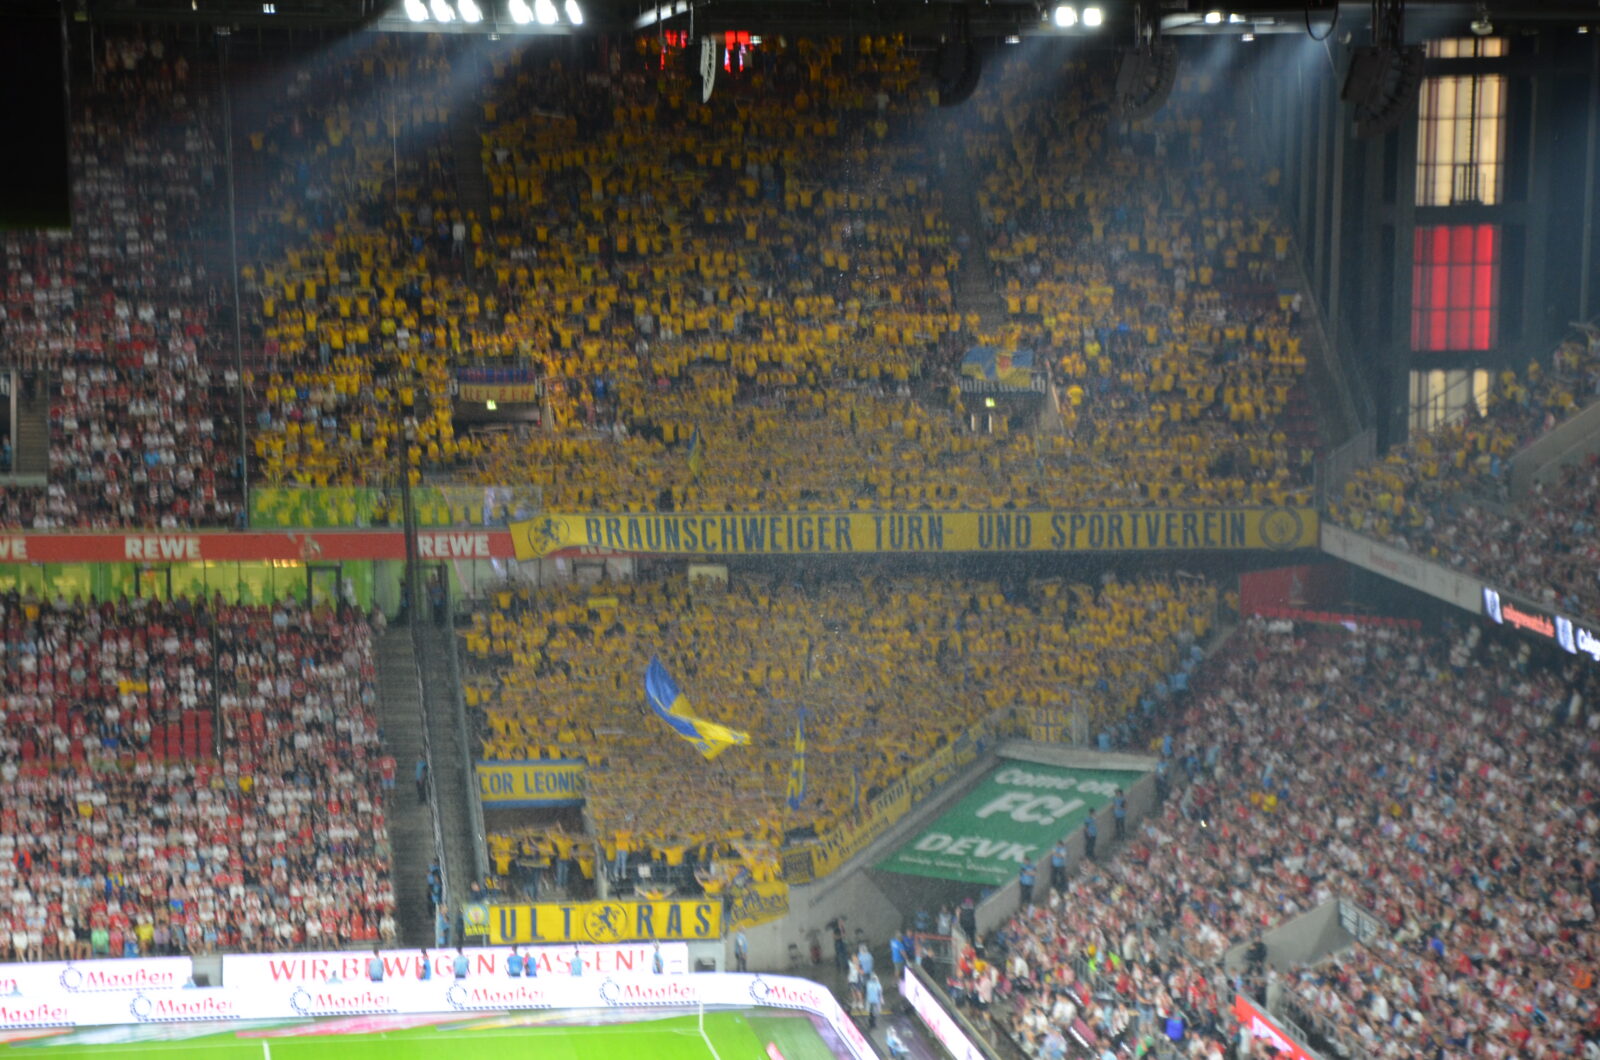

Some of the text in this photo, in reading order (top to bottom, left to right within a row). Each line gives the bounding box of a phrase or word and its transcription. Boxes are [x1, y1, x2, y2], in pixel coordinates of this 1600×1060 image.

[584, 516, 853, 552] BRAUNSCHWEIGER
[977, 512, 1032, 549] UND
[1049, 511, 1245, 549] SPORTVEREIN
[124, 536, 202, 560] REWE
[416, 535, 491, 557] REWE
[479, 773, 513, 794] COR
[995, 769, 1077, 789] Come
[975, 792, 1087, 826] FC!
[914, 833, 1040, 864] DEVK
[87, 968, 173, 988] Maaßen
[269, 959, 329, 982] WIR
[341, 954, 495, 980] BEWEGN
